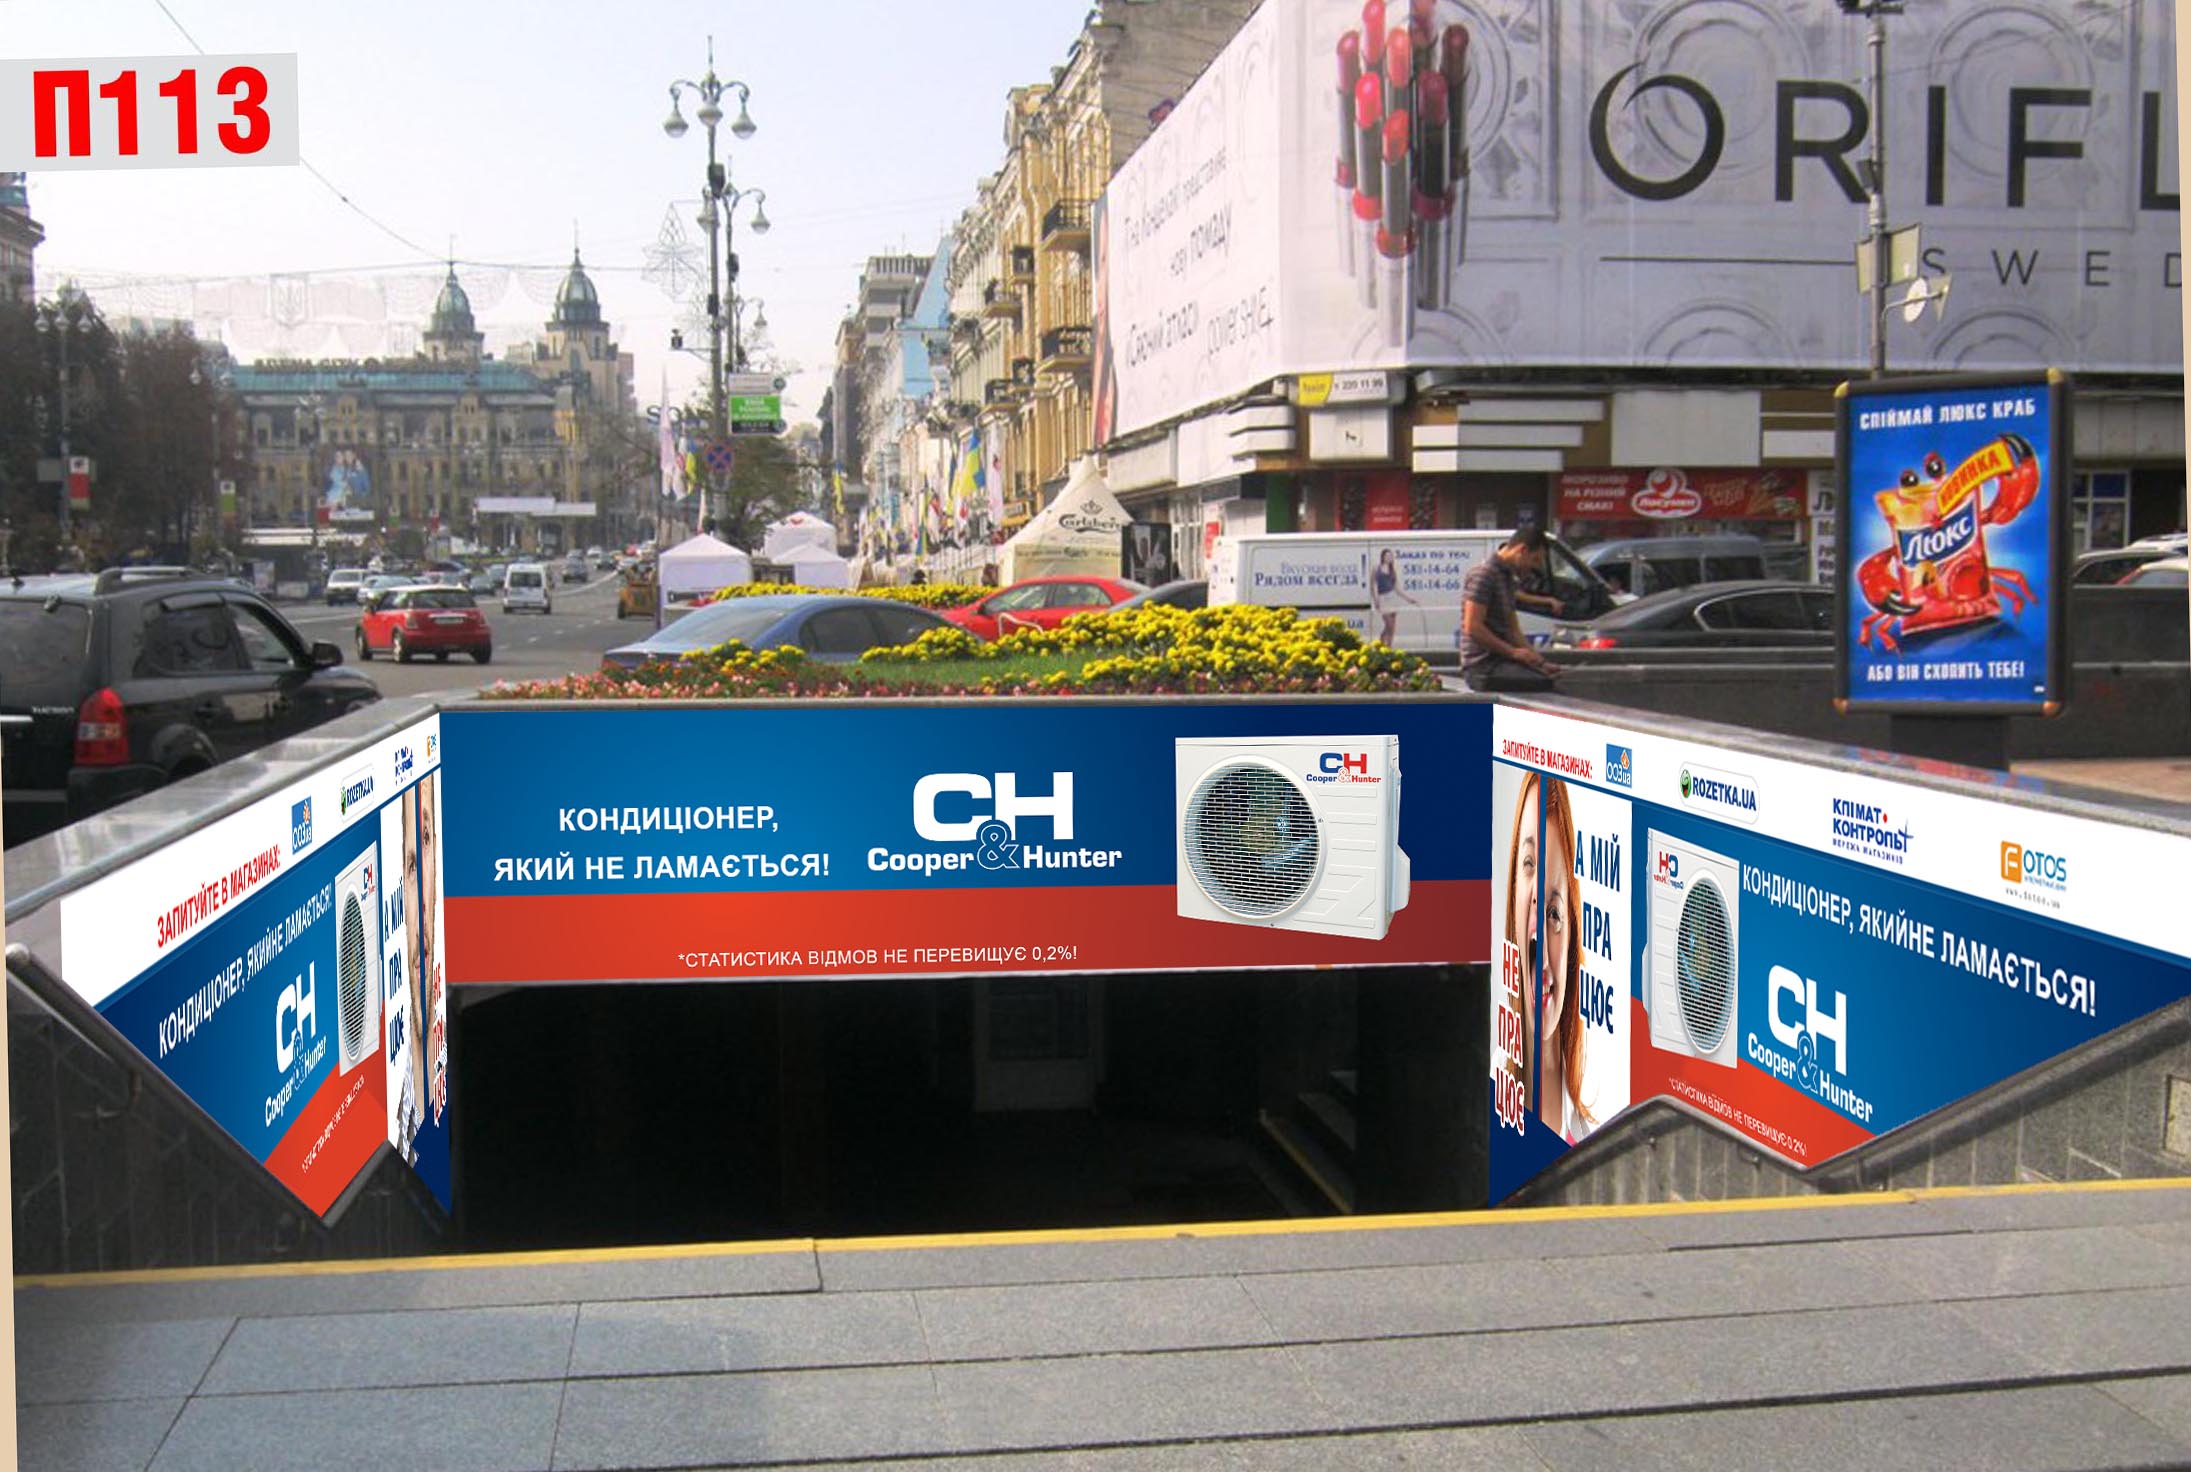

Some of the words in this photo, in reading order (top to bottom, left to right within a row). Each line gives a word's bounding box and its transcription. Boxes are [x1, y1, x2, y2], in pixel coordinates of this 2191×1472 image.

[1860, 403, 1932, 430] СПІЙМАЙ
[1940, 402, 1986, 423] ЛЮКС
[1992, 399, 2035, 417] КРАБ
[1903, 514, 1972, 562] Люкс
[1255, 572, 1303, 588] Рядом
[1867, 664, 1892, 682] АБО
[1897, 663, 1919, 681] ВІН
[1924, 661, 1984, 681] СХОПИТЬ
[1988, 660, 2025, 678] ТЕБЕ!
[1306, 774, 1338, 784] Cooper
[1351, 775, 1382, 783] Hunter
[1319, 752, 1367, 774] CH
[1502, 738, 1540, 765] ЗАПИТУЙТЕ
[1540, 749, 1546, 766] В
[1547, 751, 1593, 780] МАГАЗИНАХ:
[913, 771, 1074, 842] CH
[1692, 775, 1757, 812] ROZETKA.UA
[559, 805, 779, 834] КОНДИЦІОНЕР,
[494, 851, 574, 881] ЯКИЙ
[585, 857, 625, 880] НЕ
[634, 853, 830, 880] ЛАМАЄТЬСЯ!
[867, 847, 974, 877] Cooper
[1023, 845, 1123, 869] Hunter
[1574, 830, 1585, 878] А
[1590, 833, 1621, 892] МІЙ
[158, 881, 219, 948] ЗАПИТУЙТЕ
[222, 877, 228, 905] В
[230, 844, 281, 899] МАГАЗИНАХ:
[1582, 900, 1612, 961] ПРА
[1743, 863, 1854, 934] КОНДИЦІОНЕР,
[1858, 904, 1935, 958] ЯКИЙНЕ
[1941, 931, 2096, 1017] ЛАМАЄТЬСЯ!
[159, 956, 245, 1059] КОНДИЦІОНЕР,
[285, 882, 332, 948] ЛАМАЄТЬСЯ!
[808, 949, 877, 967] ВІДМОВ
[884, 949, 907, 964] НЕ
[914, 947, 1027, 965] ПЕРЕВИЩУЄ
[1032, 945, 1078, 962] 0,2%!
[1502, 942, 1519, 992] НЕ
[1580, 969, 1614, 1034] ЦЮЄ
[1768, 964, 1847, 1076] CH
[1498, 1004, 1523, 1065] ПРА
[265, 1079, 294, 1127] Cooper
[304, 1035, 327, 1077] Hunter
[1494, 1066, 1524, 1133] ЦЮЄ
[1748, 1032, 1796, 1079] Cooper
[1819, 1069, 1873, 1123] Hunter
[1733, 1108, 1743, 1124] НЕ
